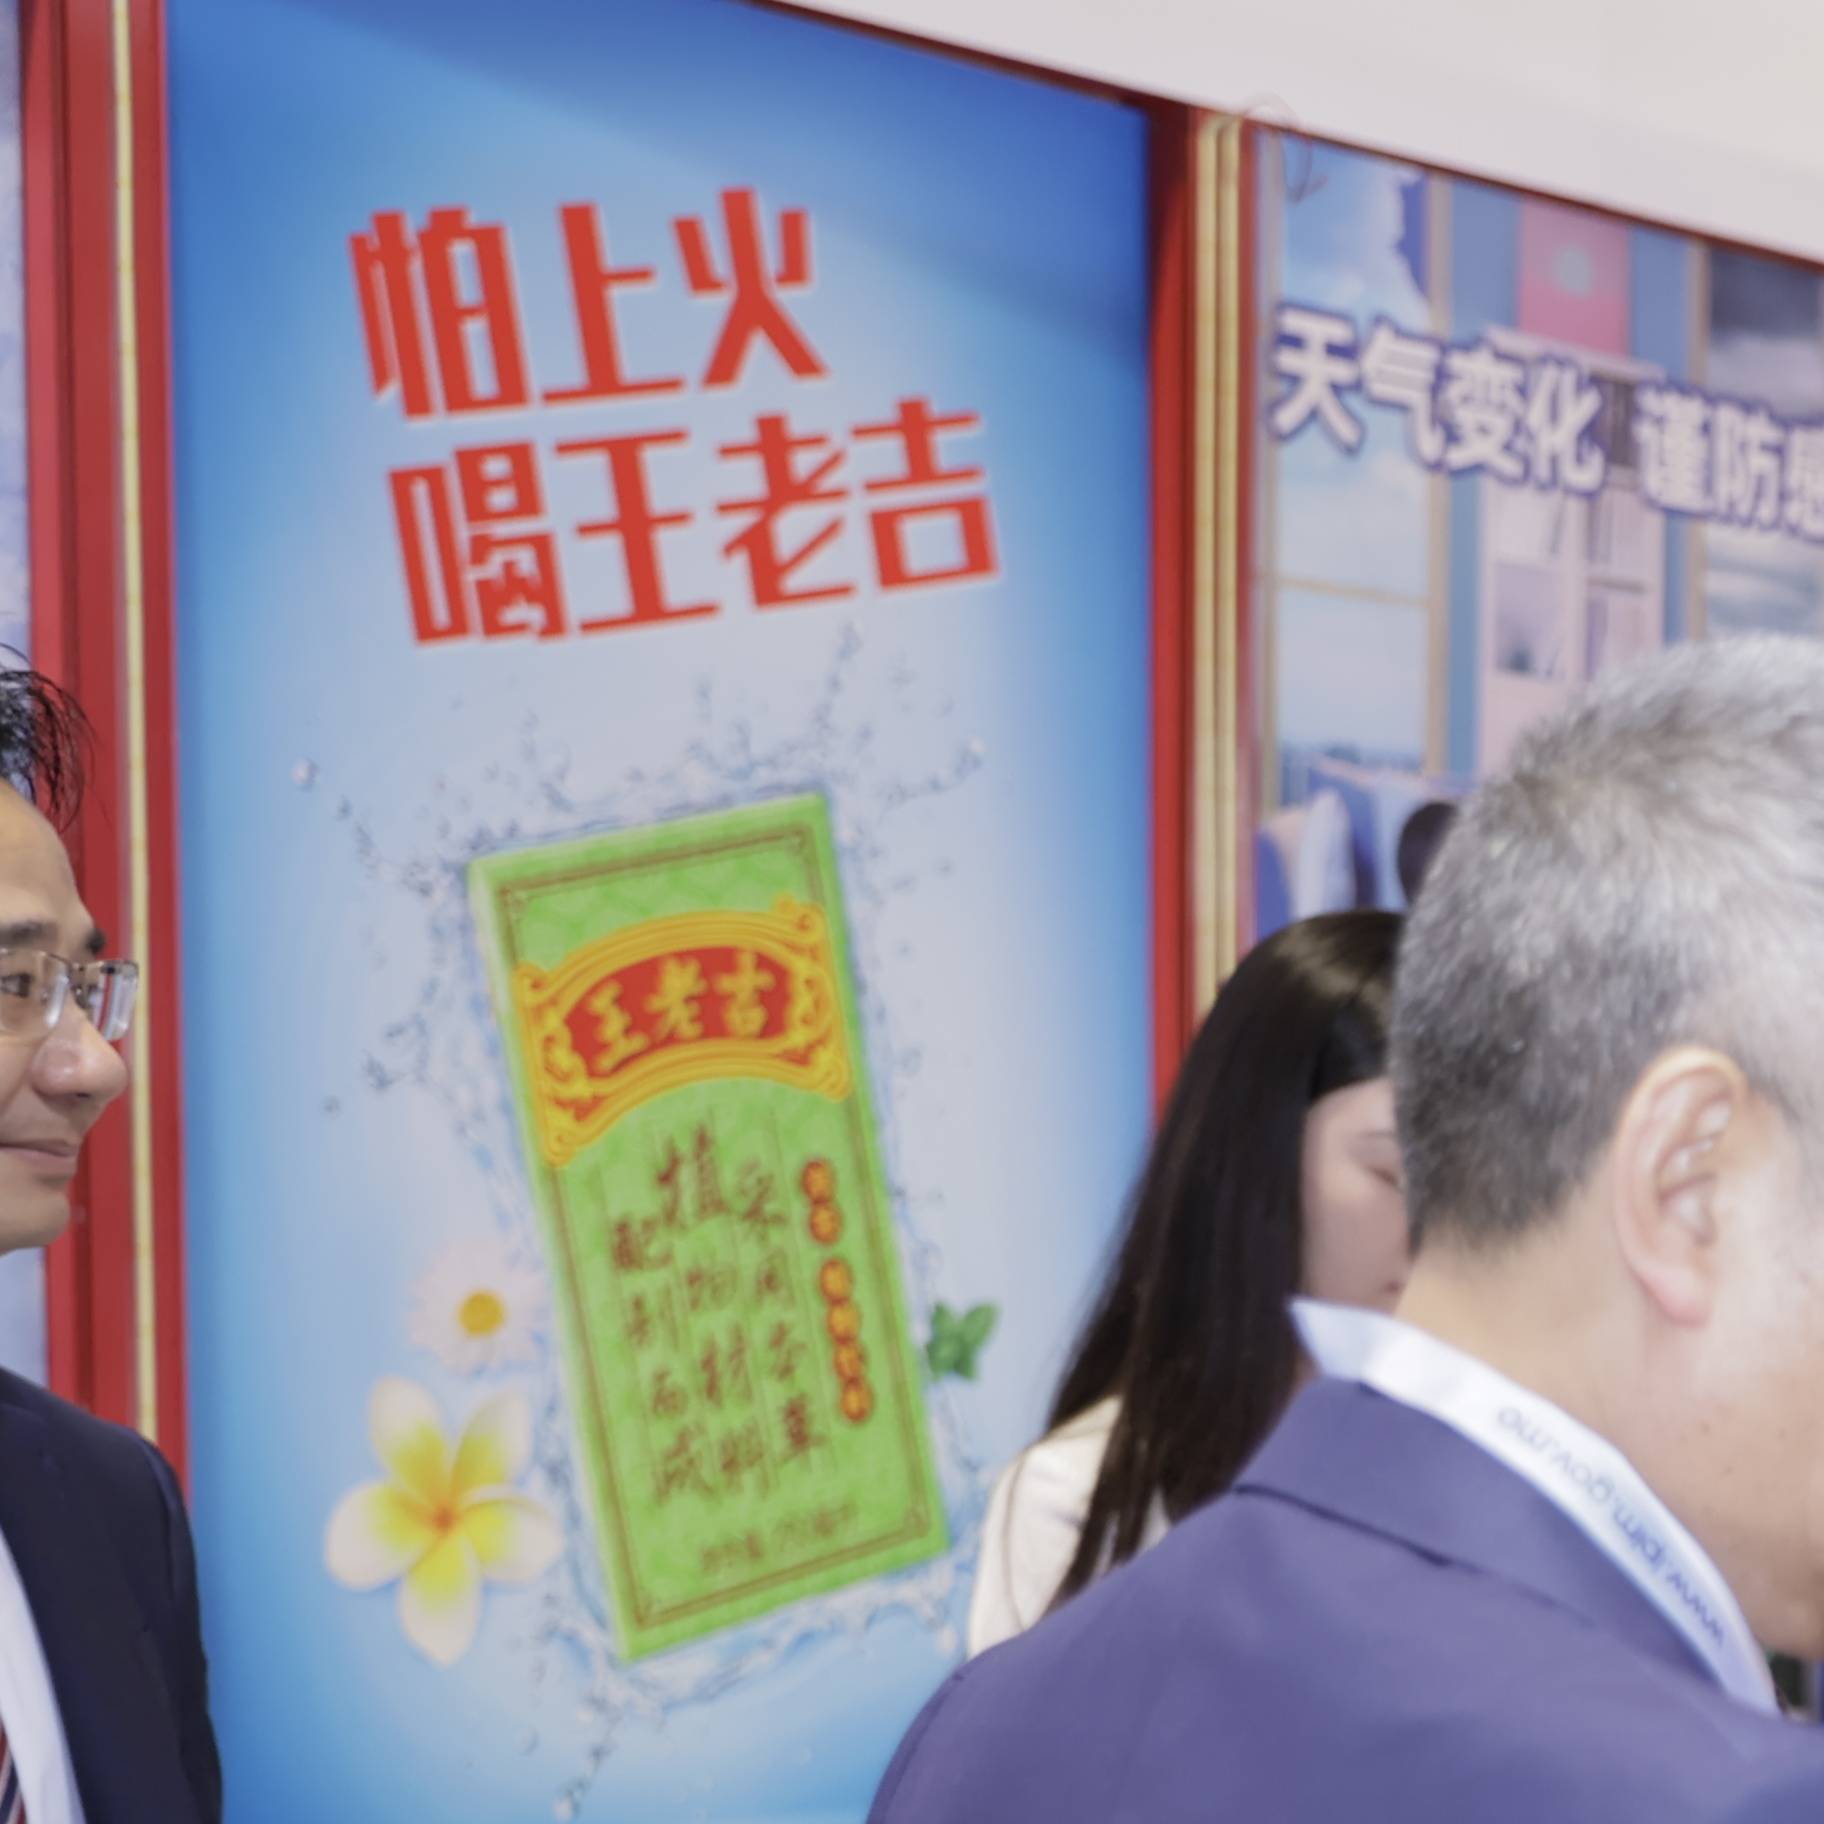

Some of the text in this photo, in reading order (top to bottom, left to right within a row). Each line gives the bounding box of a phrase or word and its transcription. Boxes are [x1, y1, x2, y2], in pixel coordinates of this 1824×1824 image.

[348, 187, 830, 420] 怕上火
[1268, 304, 1606, 496] 天气变化
[387, 396, 1000, 647] 喝王老吉
[592, 948, 776, 1075] 王老吉
